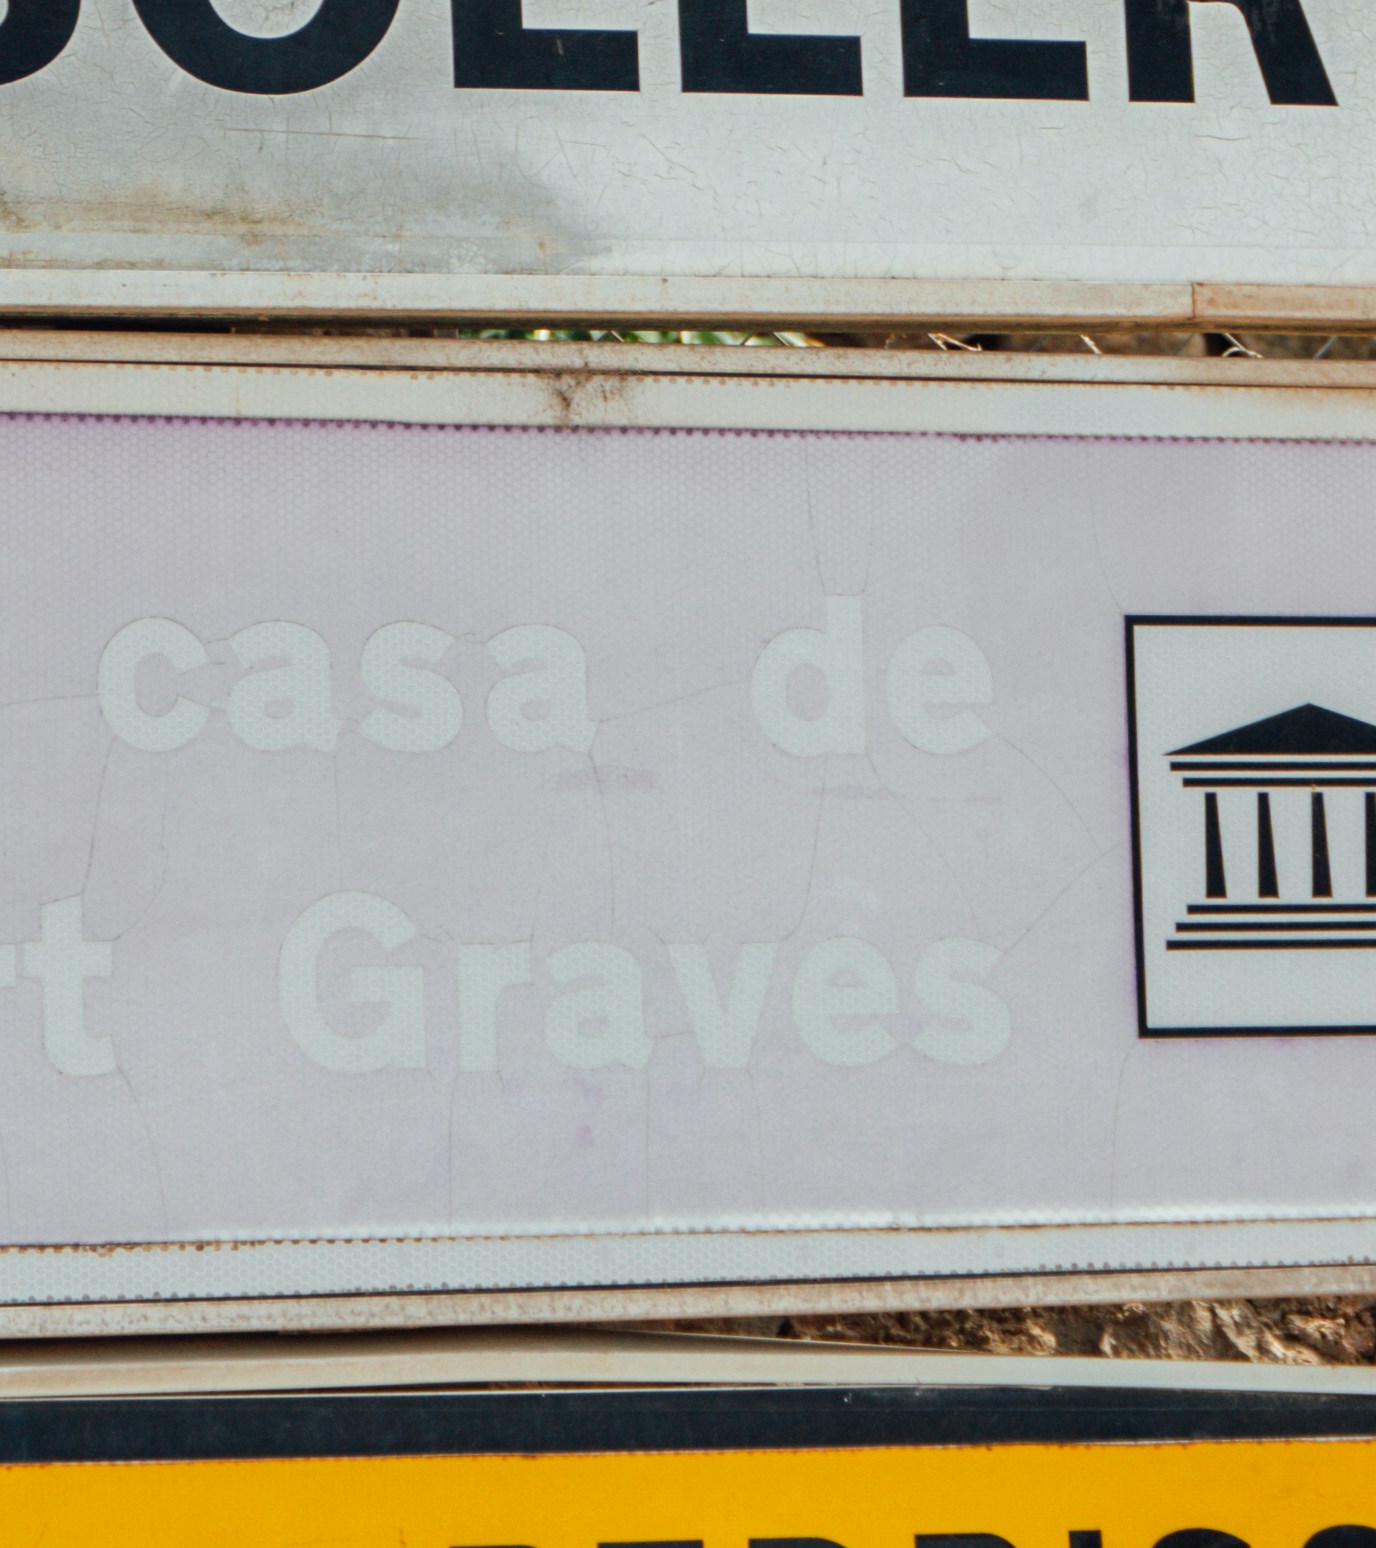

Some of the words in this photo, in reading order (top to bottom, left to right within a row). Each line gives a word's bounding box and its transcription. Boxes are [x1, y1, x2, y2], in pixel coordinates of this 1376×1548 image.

[97, 615, 600, 755] casa
[750, 594, 995, 758] de
[277, 888, 1016, 1076] Graves
